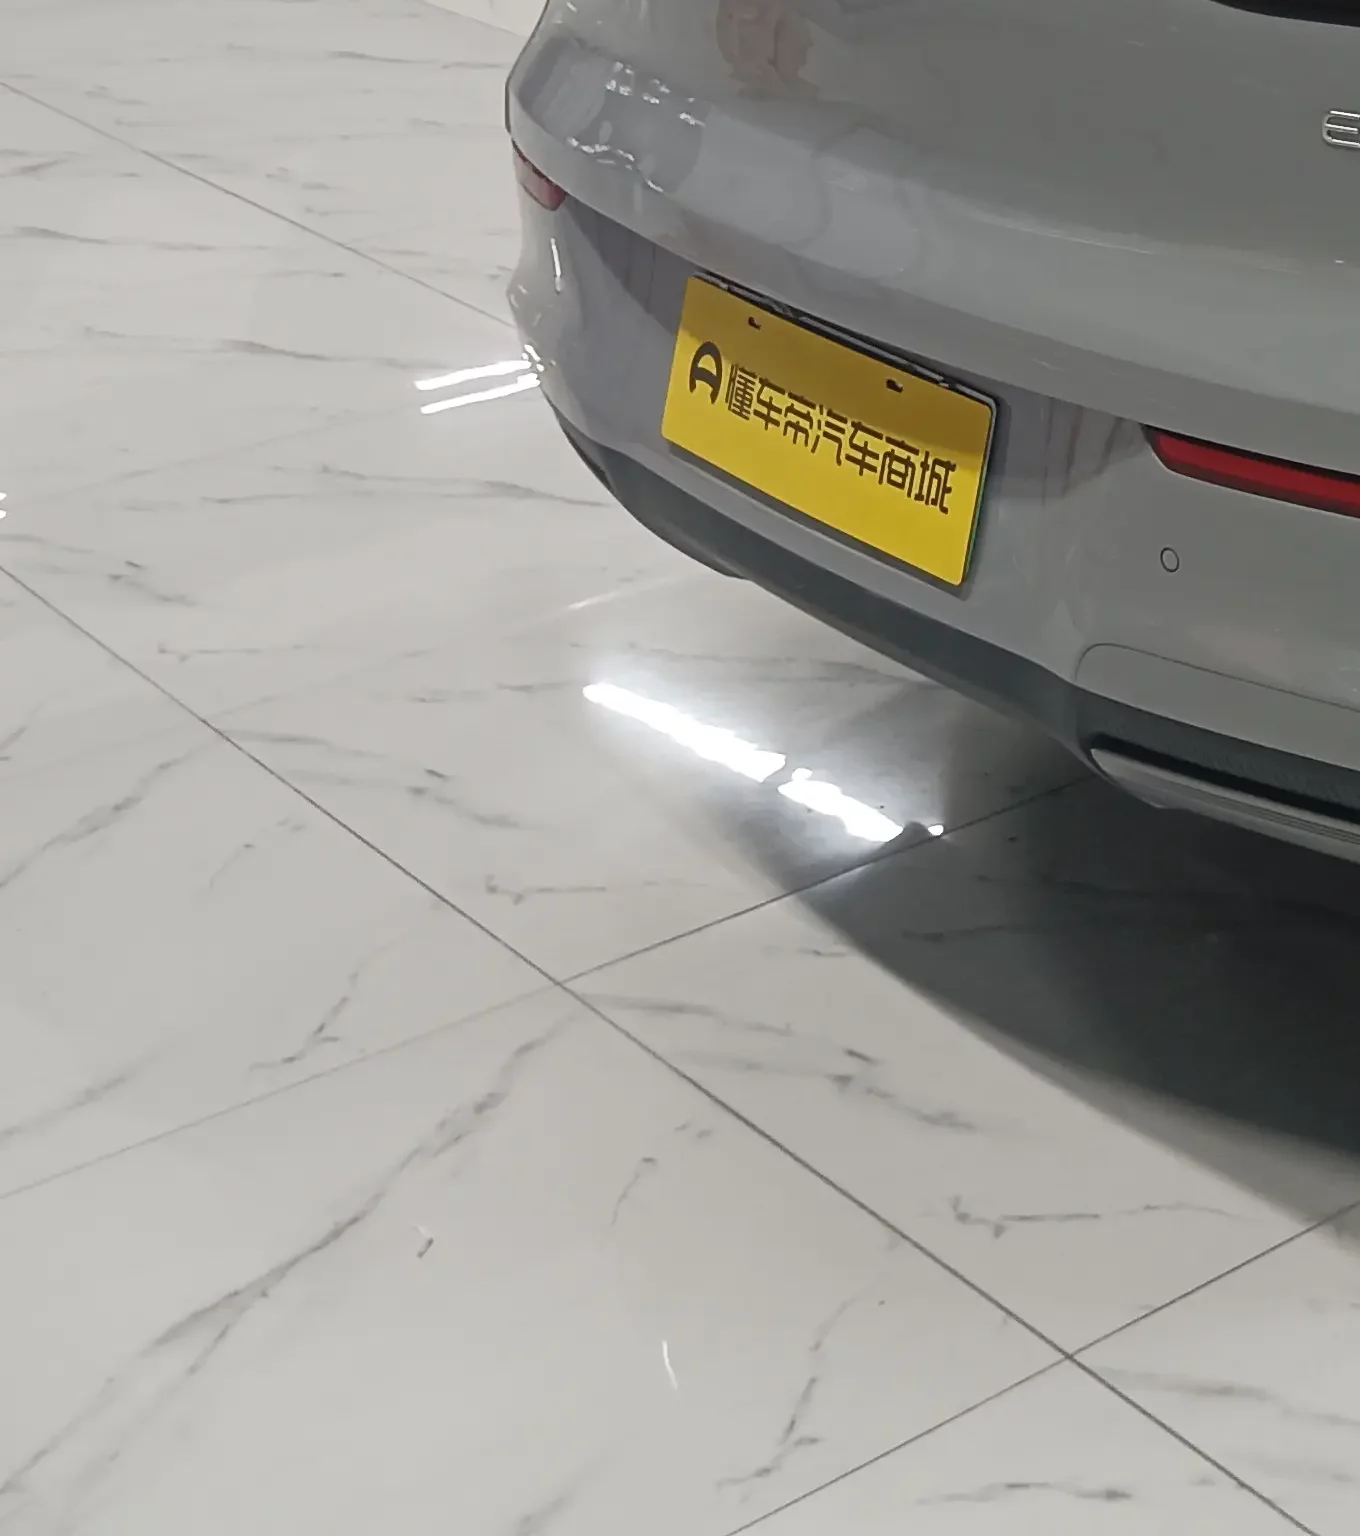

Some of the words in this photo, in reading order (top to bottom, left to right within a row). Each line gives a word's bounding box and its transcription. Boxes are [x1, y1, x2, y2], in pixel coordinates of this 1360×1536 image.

[725, 363, 956, 515] 懂车帝汽车商城
